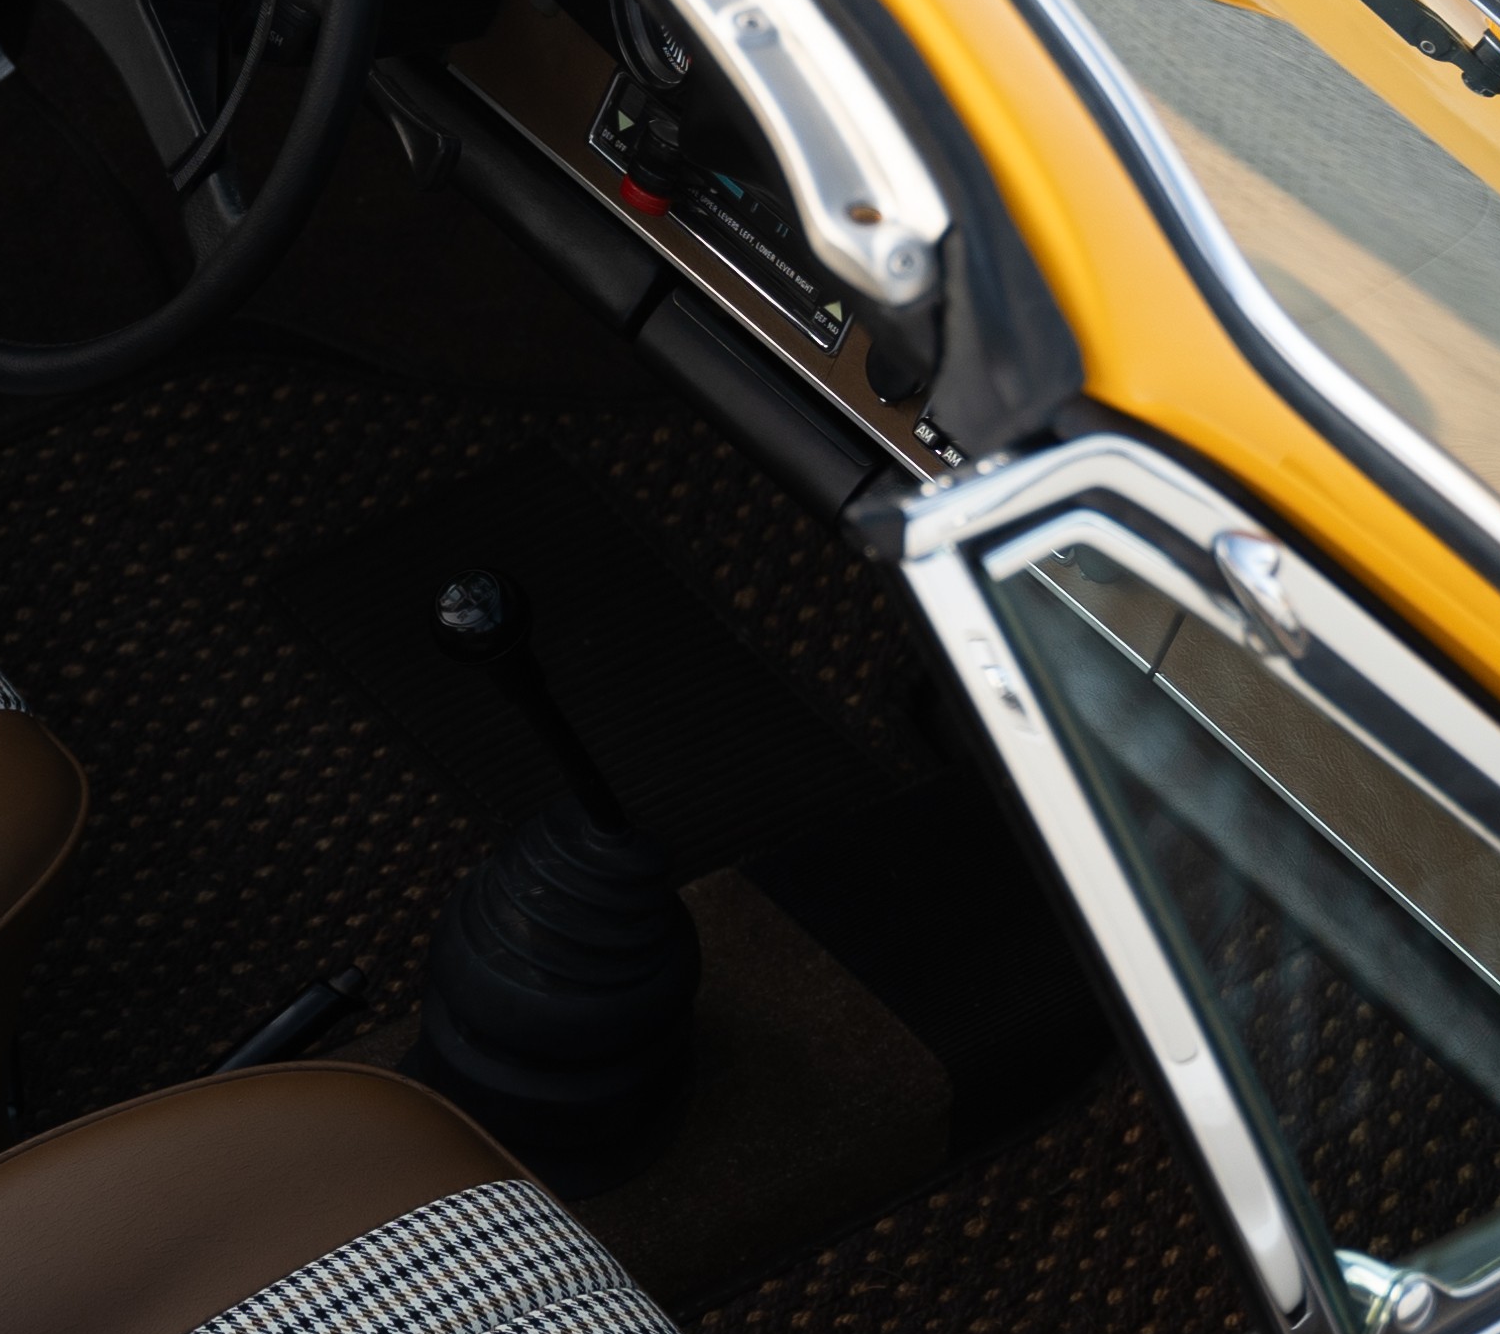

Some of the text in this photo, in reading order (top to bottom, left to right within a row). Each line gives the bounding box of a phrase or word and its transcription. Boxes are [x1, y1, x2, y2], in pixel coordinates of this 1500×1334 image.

[614, 139, 628, 152] OFF
[717, 209, 740, 231] LEVERS
[739, 229, 755, 247] LEFT,
[755, 241, 776, 263] LOWER
[775, 259, 795, 280] LEVER
[795, 275, 815, 294] RIGHT
[915, 425, 936, 443] AM
[944, 449, 964, 468] AM
